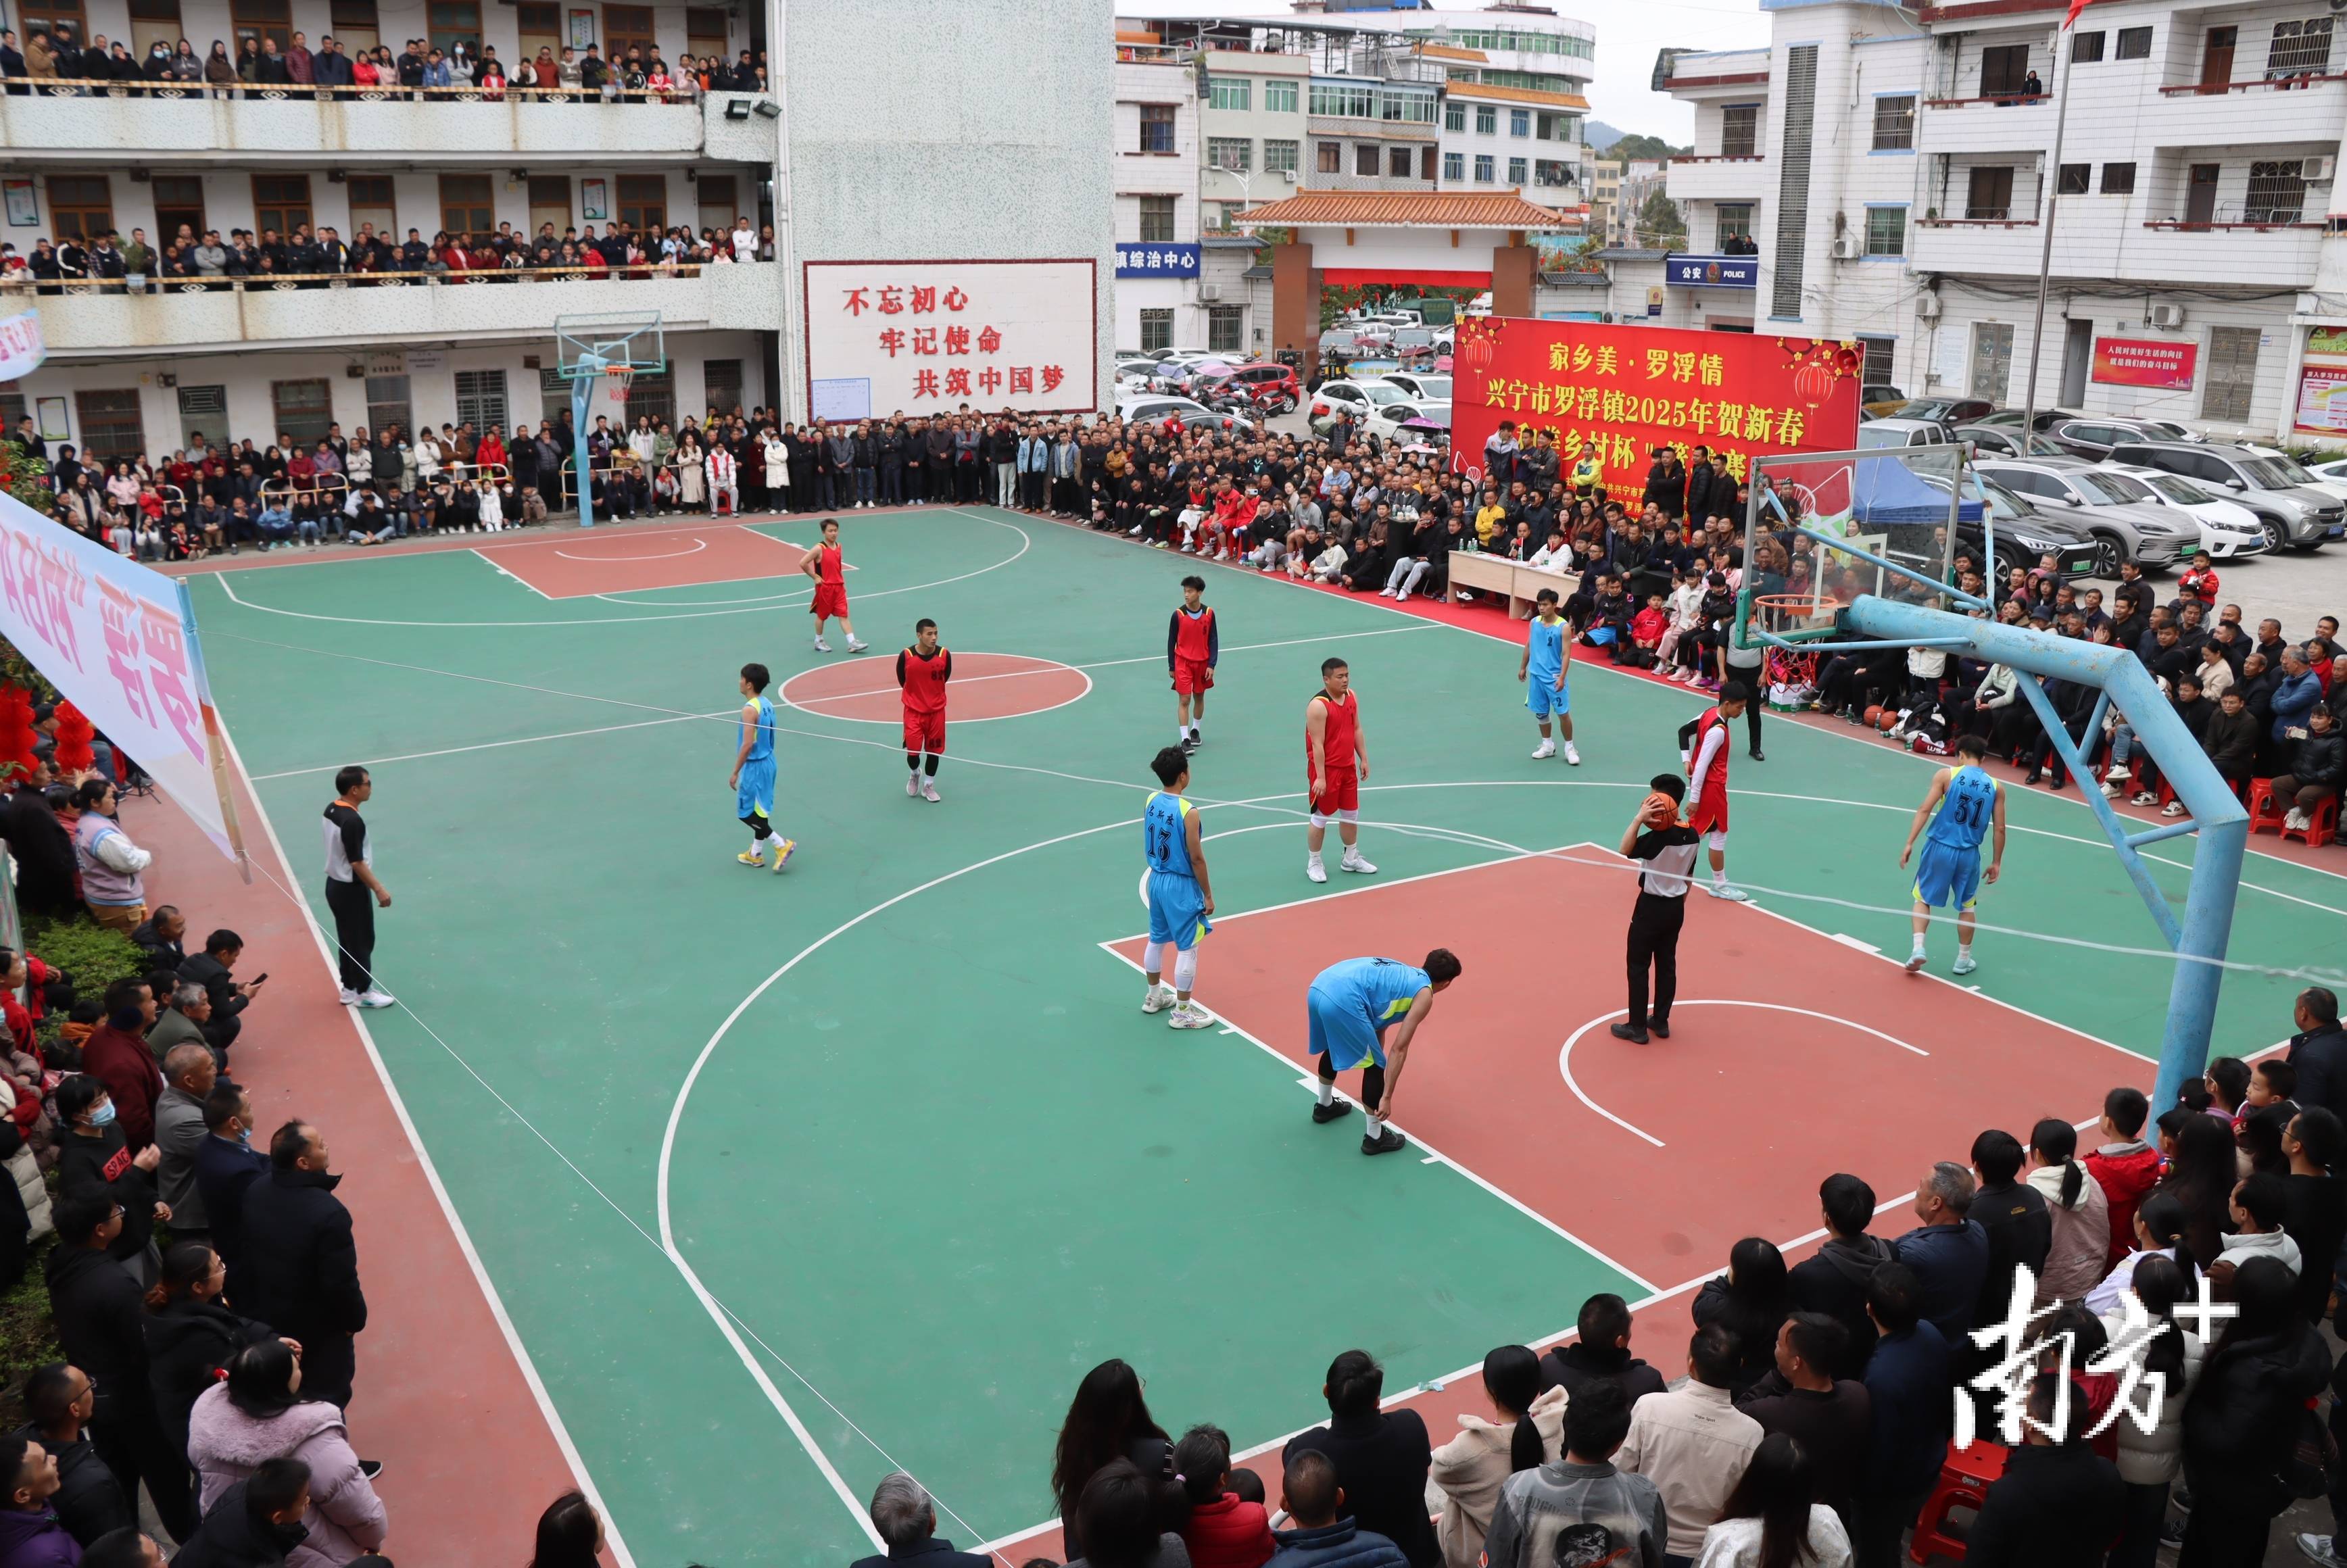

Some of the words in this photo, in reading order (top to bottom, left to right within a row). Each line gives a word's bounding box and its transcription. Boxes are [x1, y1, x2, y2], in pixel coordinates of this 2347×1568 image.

[1115, 250, 1195, 269] 镇综治中心
[1682, 266, 1701, 279] 公安
[1723, 270, 1745, 278] POLICE
[842, 285, 969, 316] 不忘初心
[879, 325, 1002, 357] 牢记使命
[2108, 345, 2183, 360] 人民对美好生活的向往
[1549, 342, 1724, 387] 家乡美·罗浮情
[2110, 357, 2178, 370] 就是我们的奋斗目标
[913, 365, 1065, 399] 共筑中国梦
[1486, 377, 1806, 447] 兴宁市罗浮镇2025年贺新春
[1556, 696, 1564, 707] 2
[1954, 792, 1985, 829] 31
[1147, 823, 1171, 863] 13
